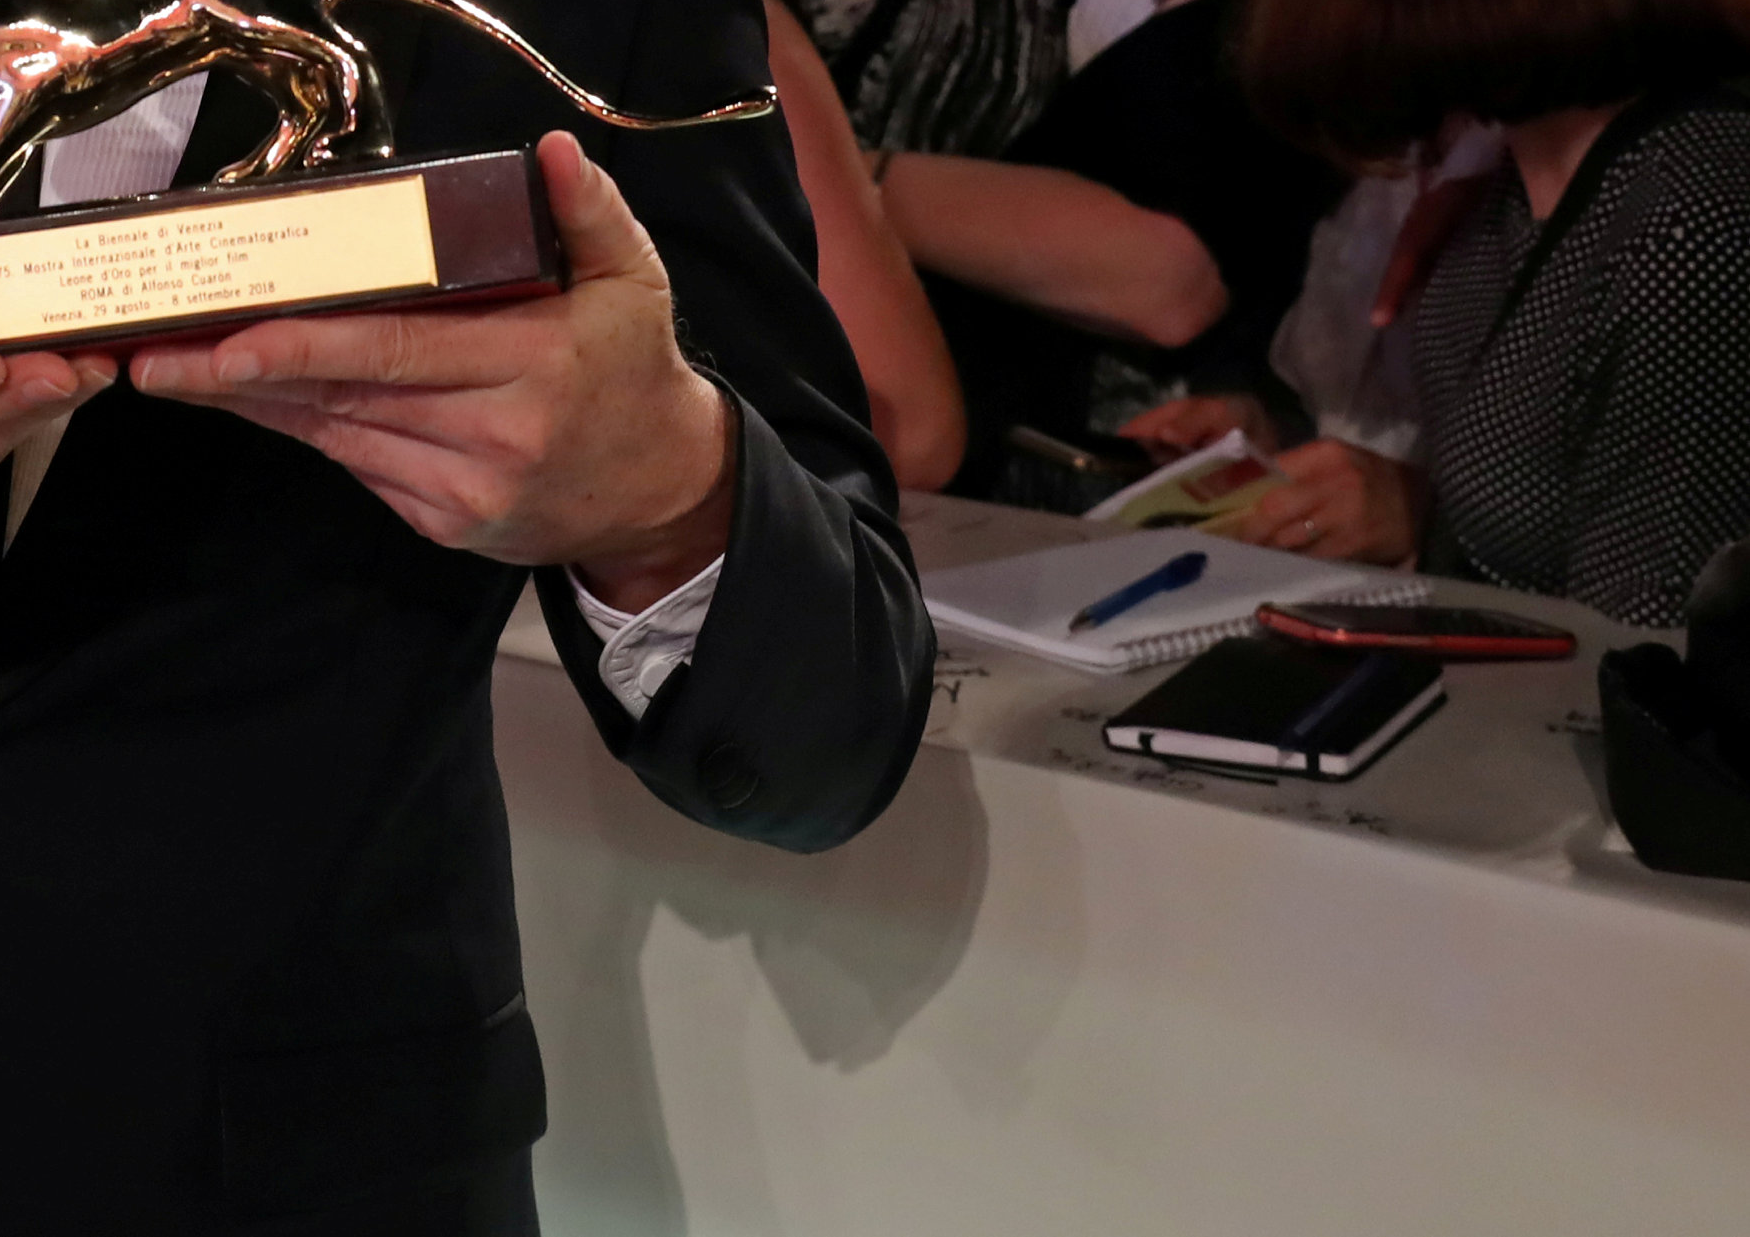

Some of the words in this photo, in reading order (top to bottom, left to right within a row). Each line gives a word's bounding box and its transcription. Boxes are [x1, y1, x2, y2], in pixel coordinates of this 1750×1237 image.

[23, 260, 65, 275] Mostra
[72, 247, 156, 267] Internazionale
[164, 240, 201, 256] d'Arte
[209, 225, 310, 249] Cinematografica
[75, 237, 90, 250] La
[98, 230, 149, 246] Biennale
[157, 226, 169, 239] di
[177, 220, 224, 235] Venezia
[59, 273, 94, 288] Leone
[100, 266, 132, 281] d'Oro
[139, 263, 158, 277] per
[165, 258, 173, 271] il
[180, 253, 219, 270] miglior
[227, 251, 249, 264] film
[80, 287, 114, 301] ROMA
[122, 282, 133, 295] di
[141, 278, 184, 292] Alfonso
[93, 304, 108, 316] 29
[114, 299, 151, 315] agosto
[171, 294, 179, 305] 8
[186, 286, 241, 305] settembre
[248, 281, 276, 296] 2018
